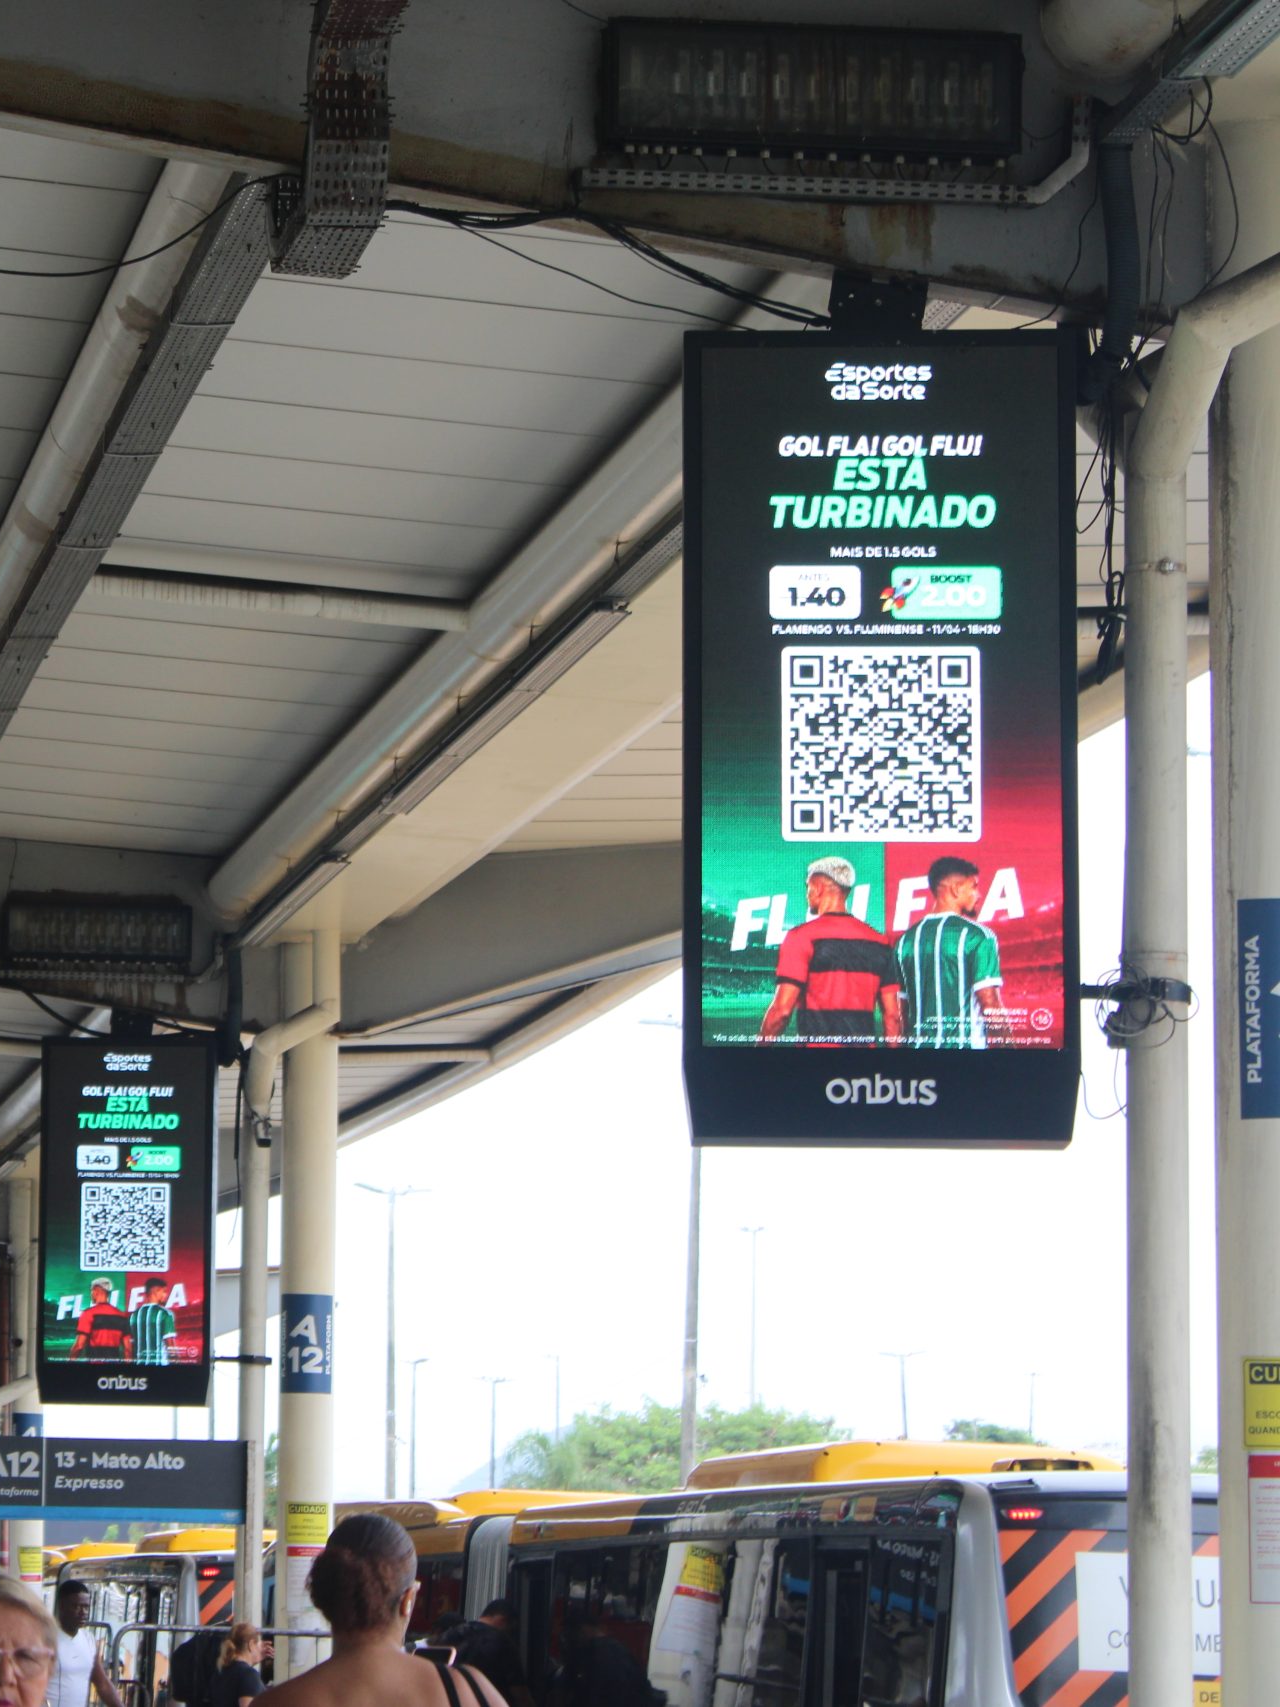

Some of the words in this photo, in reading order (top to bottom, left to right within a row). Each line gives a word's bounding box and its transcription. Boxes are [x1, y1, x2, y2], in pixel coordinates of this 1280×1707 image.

[825, 362, 932, 384] Esportes
[778, 436, 823, 456] GOL
[826, 436, 879, 456] FLA!
[881, 435, 927, 456] GOL
[929, 435, 983, 456] FLU!
[769, 495, 997, 528] TURBINADO
[830, 546, 863, 558] MAIS
[865, 546, 882, 558] DE
[883, 546, 900, 558] 1.5
[901, 546, 937, 558] GOLS
[930, 574, 972, 584] BOOST
[787, 586, 846, 607] 1.40
[920, 585, 987, 607] 2.00
[772, 624, 833, 635] FLAMENGO
[854, 624, 923, 635] FLUMINENSE
[892, 867, 1024, 931] FA
[1244, 935, 1262, 1083] PLATAFORMA
[103, 1053, 152, 1064] Esportes
[82, 1086, 103, 1097] GOL
[103, 1086, 128, 1097] FLA!
[128, 1086, 148, 1097] GOL
[149, 1087, 174, 1097] FLU!
[825, 1073, 938, 1106] onbus
[77, 1114, 180, 1129] TURBINADO
[144, 1155, 174, 1166] 2.00
[128, 1283, 188, 1313] FA
[289, 1314, 318, 1346] A
[287, 1346, 323, 1374] 12
[97, 1375, 148, 1390] onbus
[54, 1452, 75, 1468] 13
[92, 1452, 142, 1469] Mato
[144, 1452, 185, 1471] Alto
[54, 1475, 124, 1492] Expresso
